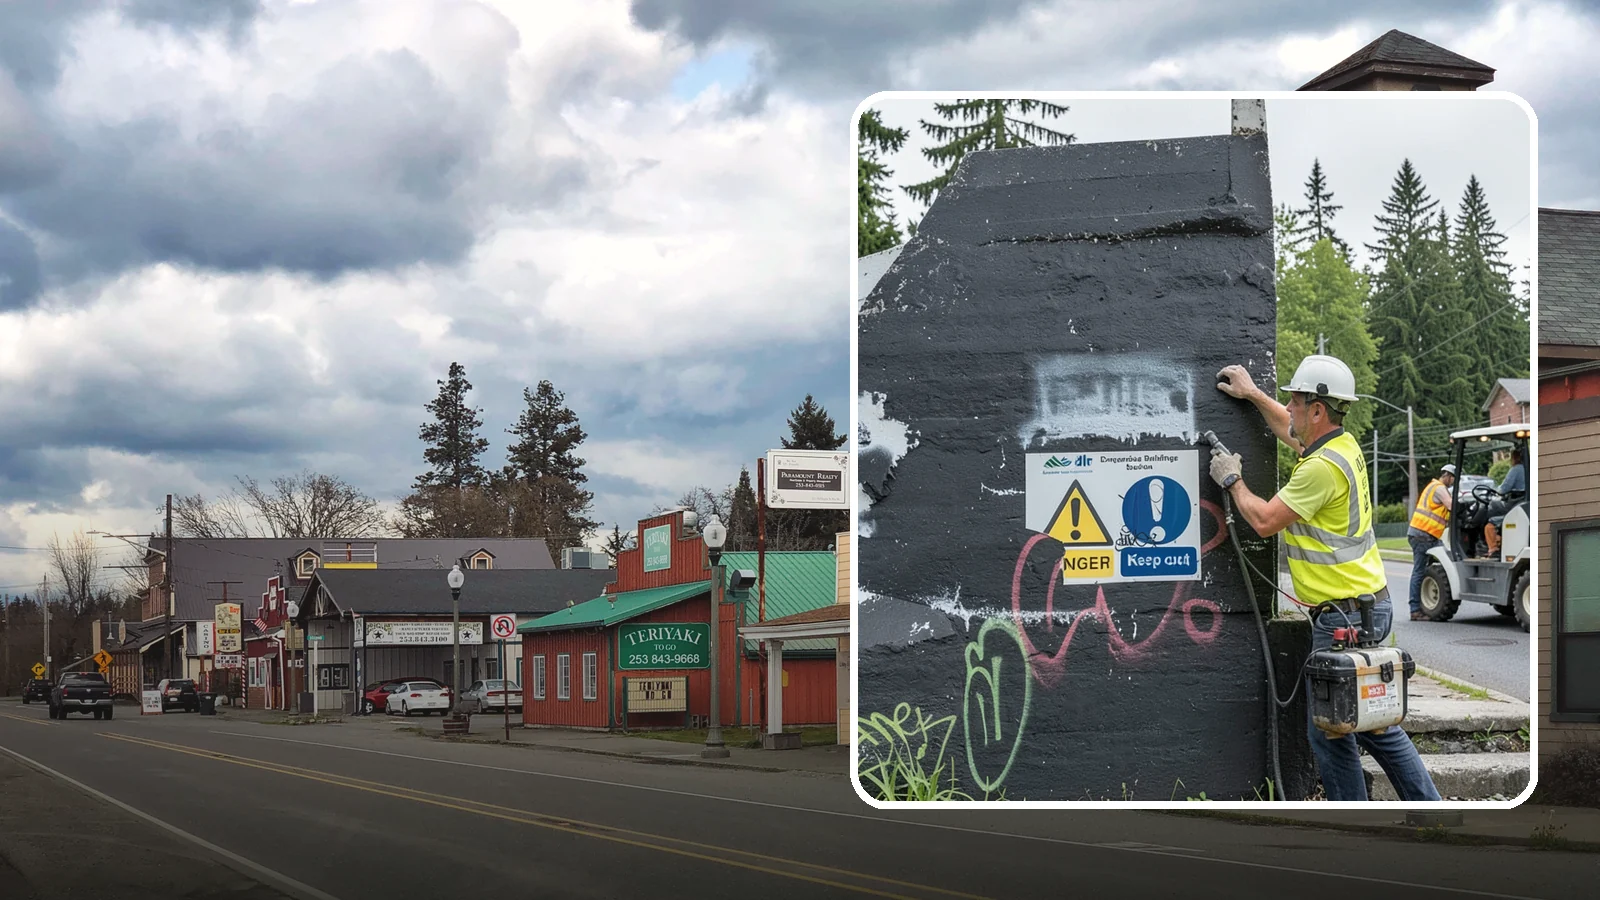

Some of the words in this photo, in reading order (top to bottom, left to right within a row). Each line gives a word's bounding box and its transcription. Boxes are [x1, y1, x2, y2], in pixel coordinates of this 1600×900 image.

[646, 531, 668, 549] TERIYAKI
[1127, 553, 1161, 569] Keep
[625, 627, 702, 646] TERIYAKI
[629, 654, 649, 665] 253
[651, 653, 700, 664] 843-9668
